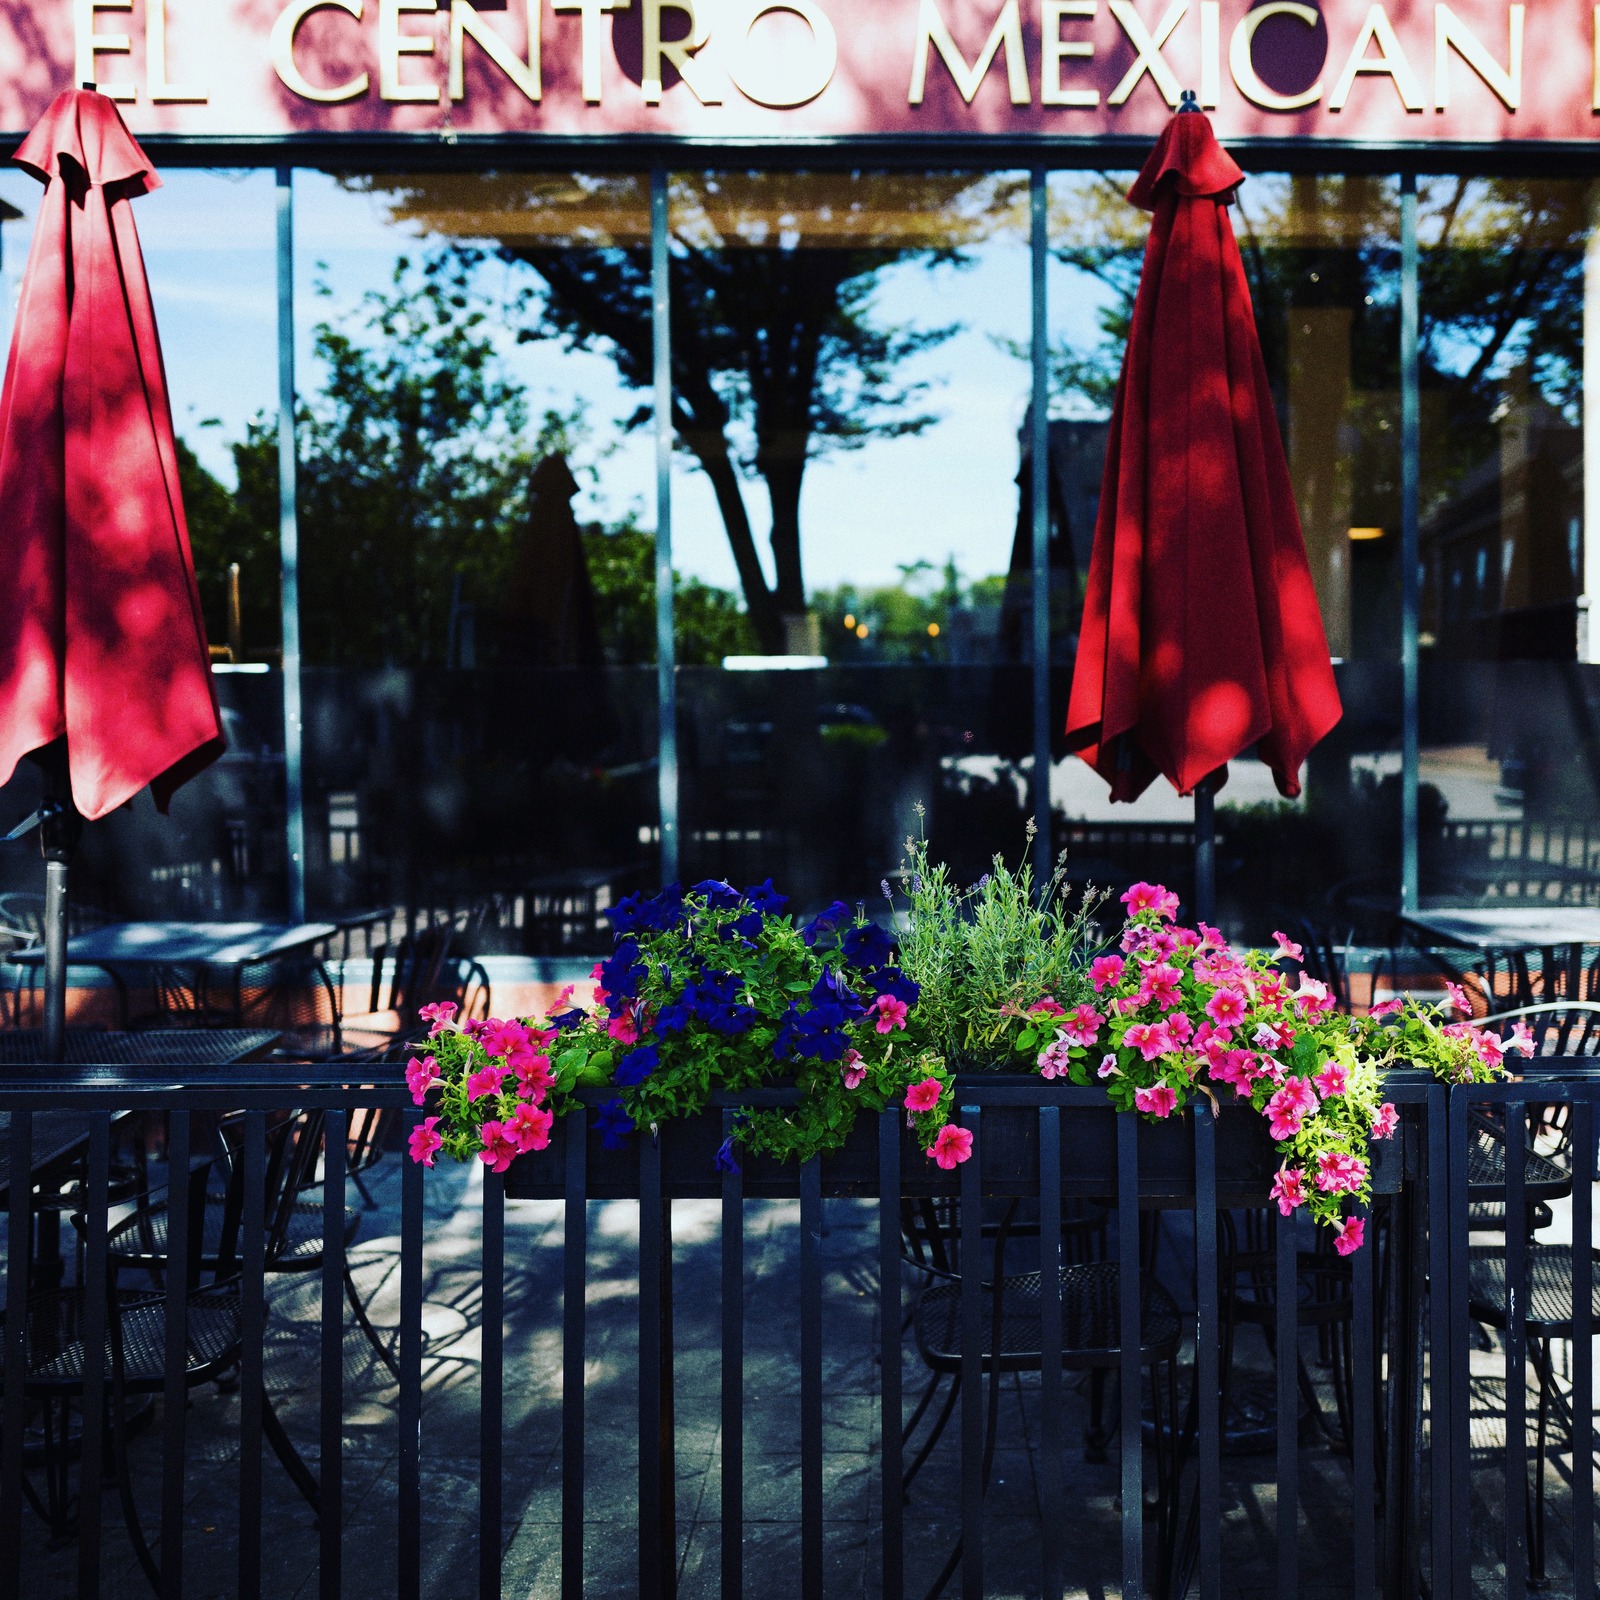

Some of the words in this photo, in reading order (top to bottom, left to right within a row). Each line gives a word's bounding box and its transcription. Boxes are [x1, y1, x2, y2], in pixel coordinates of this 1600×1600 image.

[74, 0, 209, 104] EL
[270, 0, 838, 109] CENTRO
[908, 0, 1526, 111] MEXICAN
